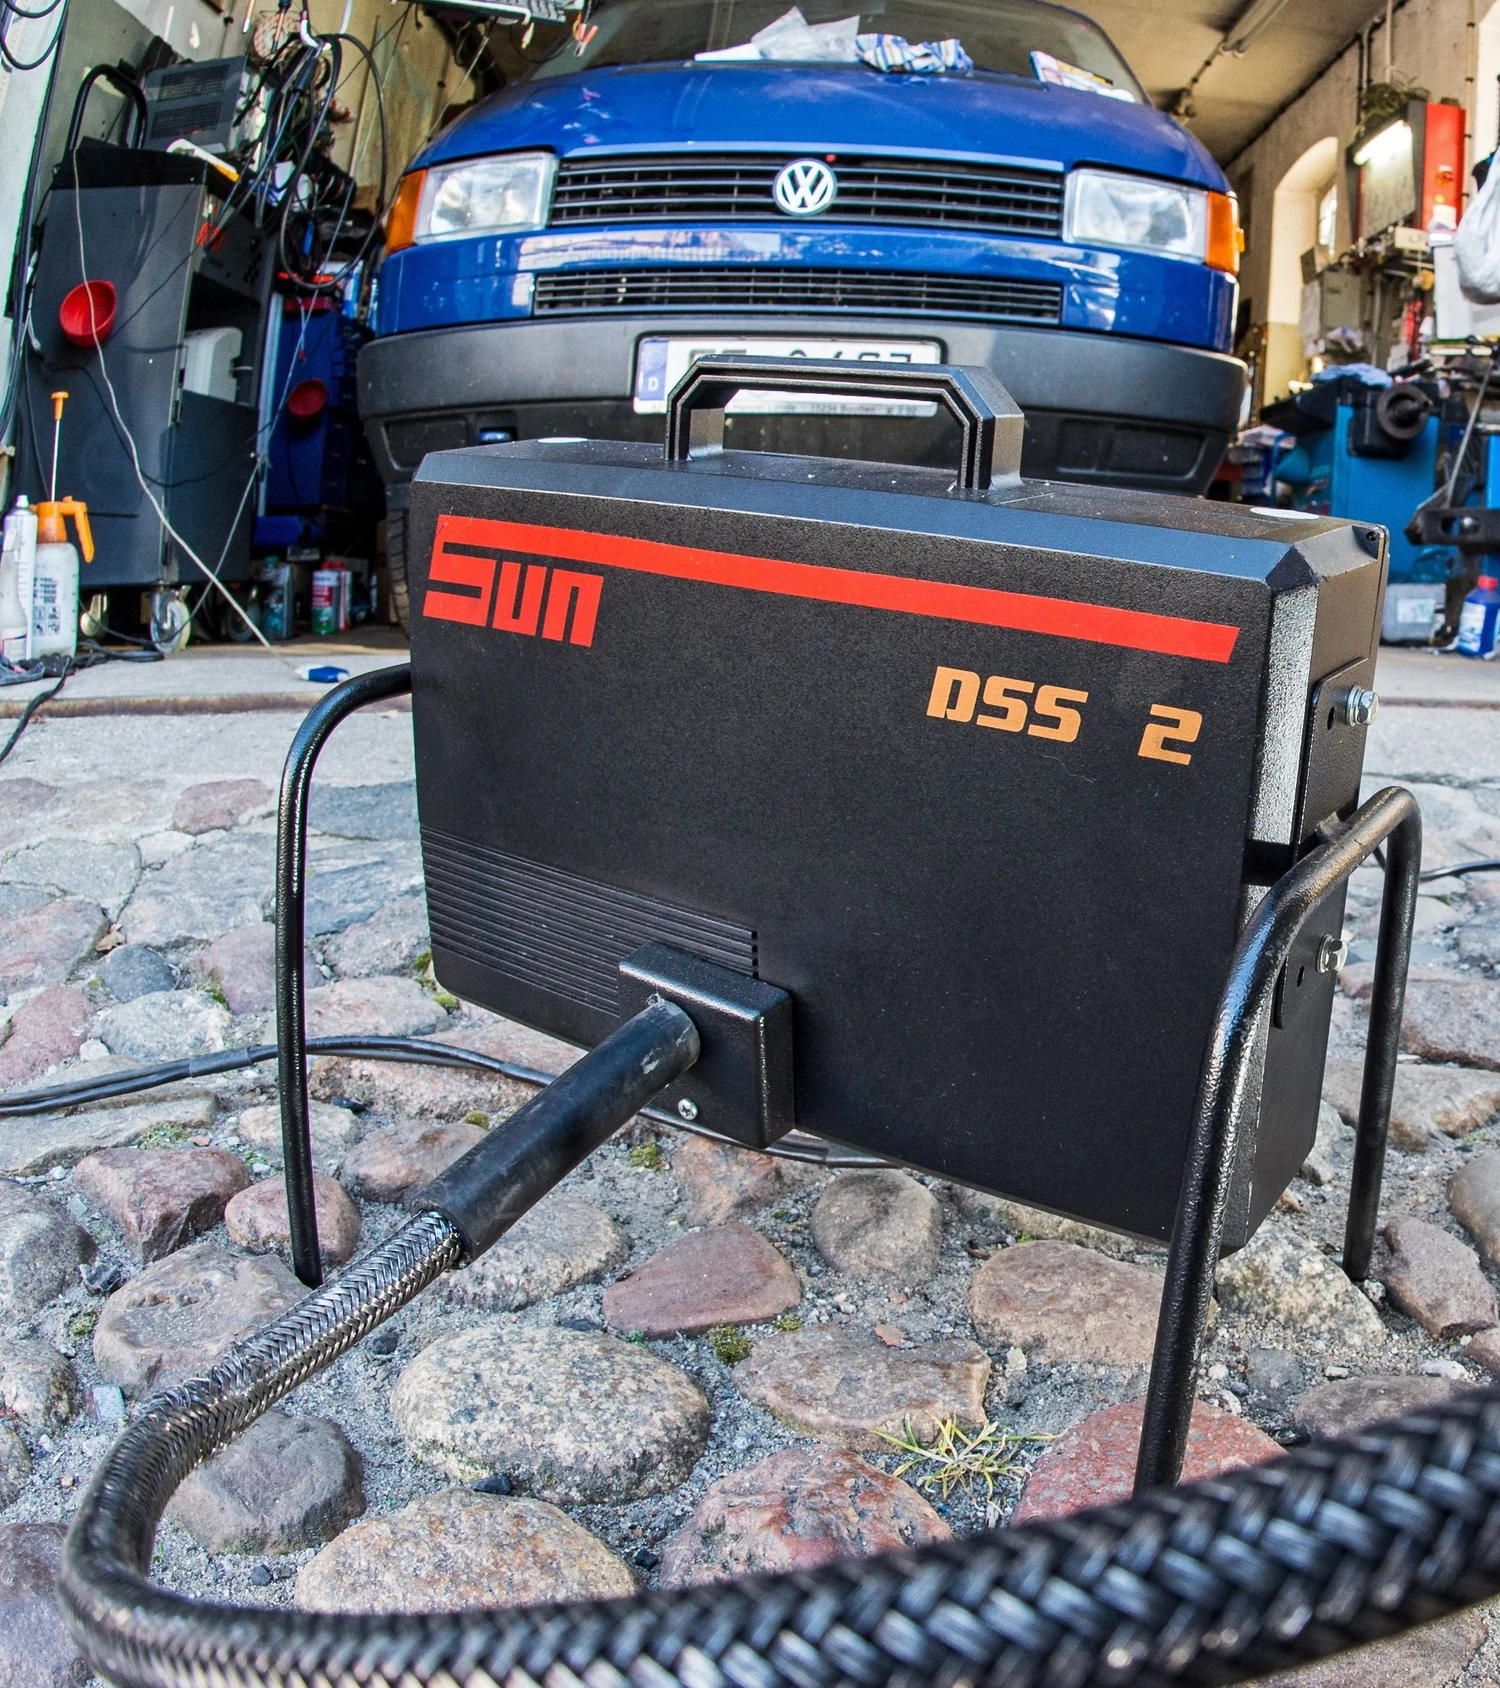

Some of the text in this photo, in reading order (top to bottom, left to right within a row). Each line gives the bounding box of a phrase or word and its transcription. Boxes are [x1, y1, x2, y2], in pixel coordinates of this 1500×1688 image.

[775, 159, 836, 214] VW
[926, 666, 1203, 766] DSS 2
